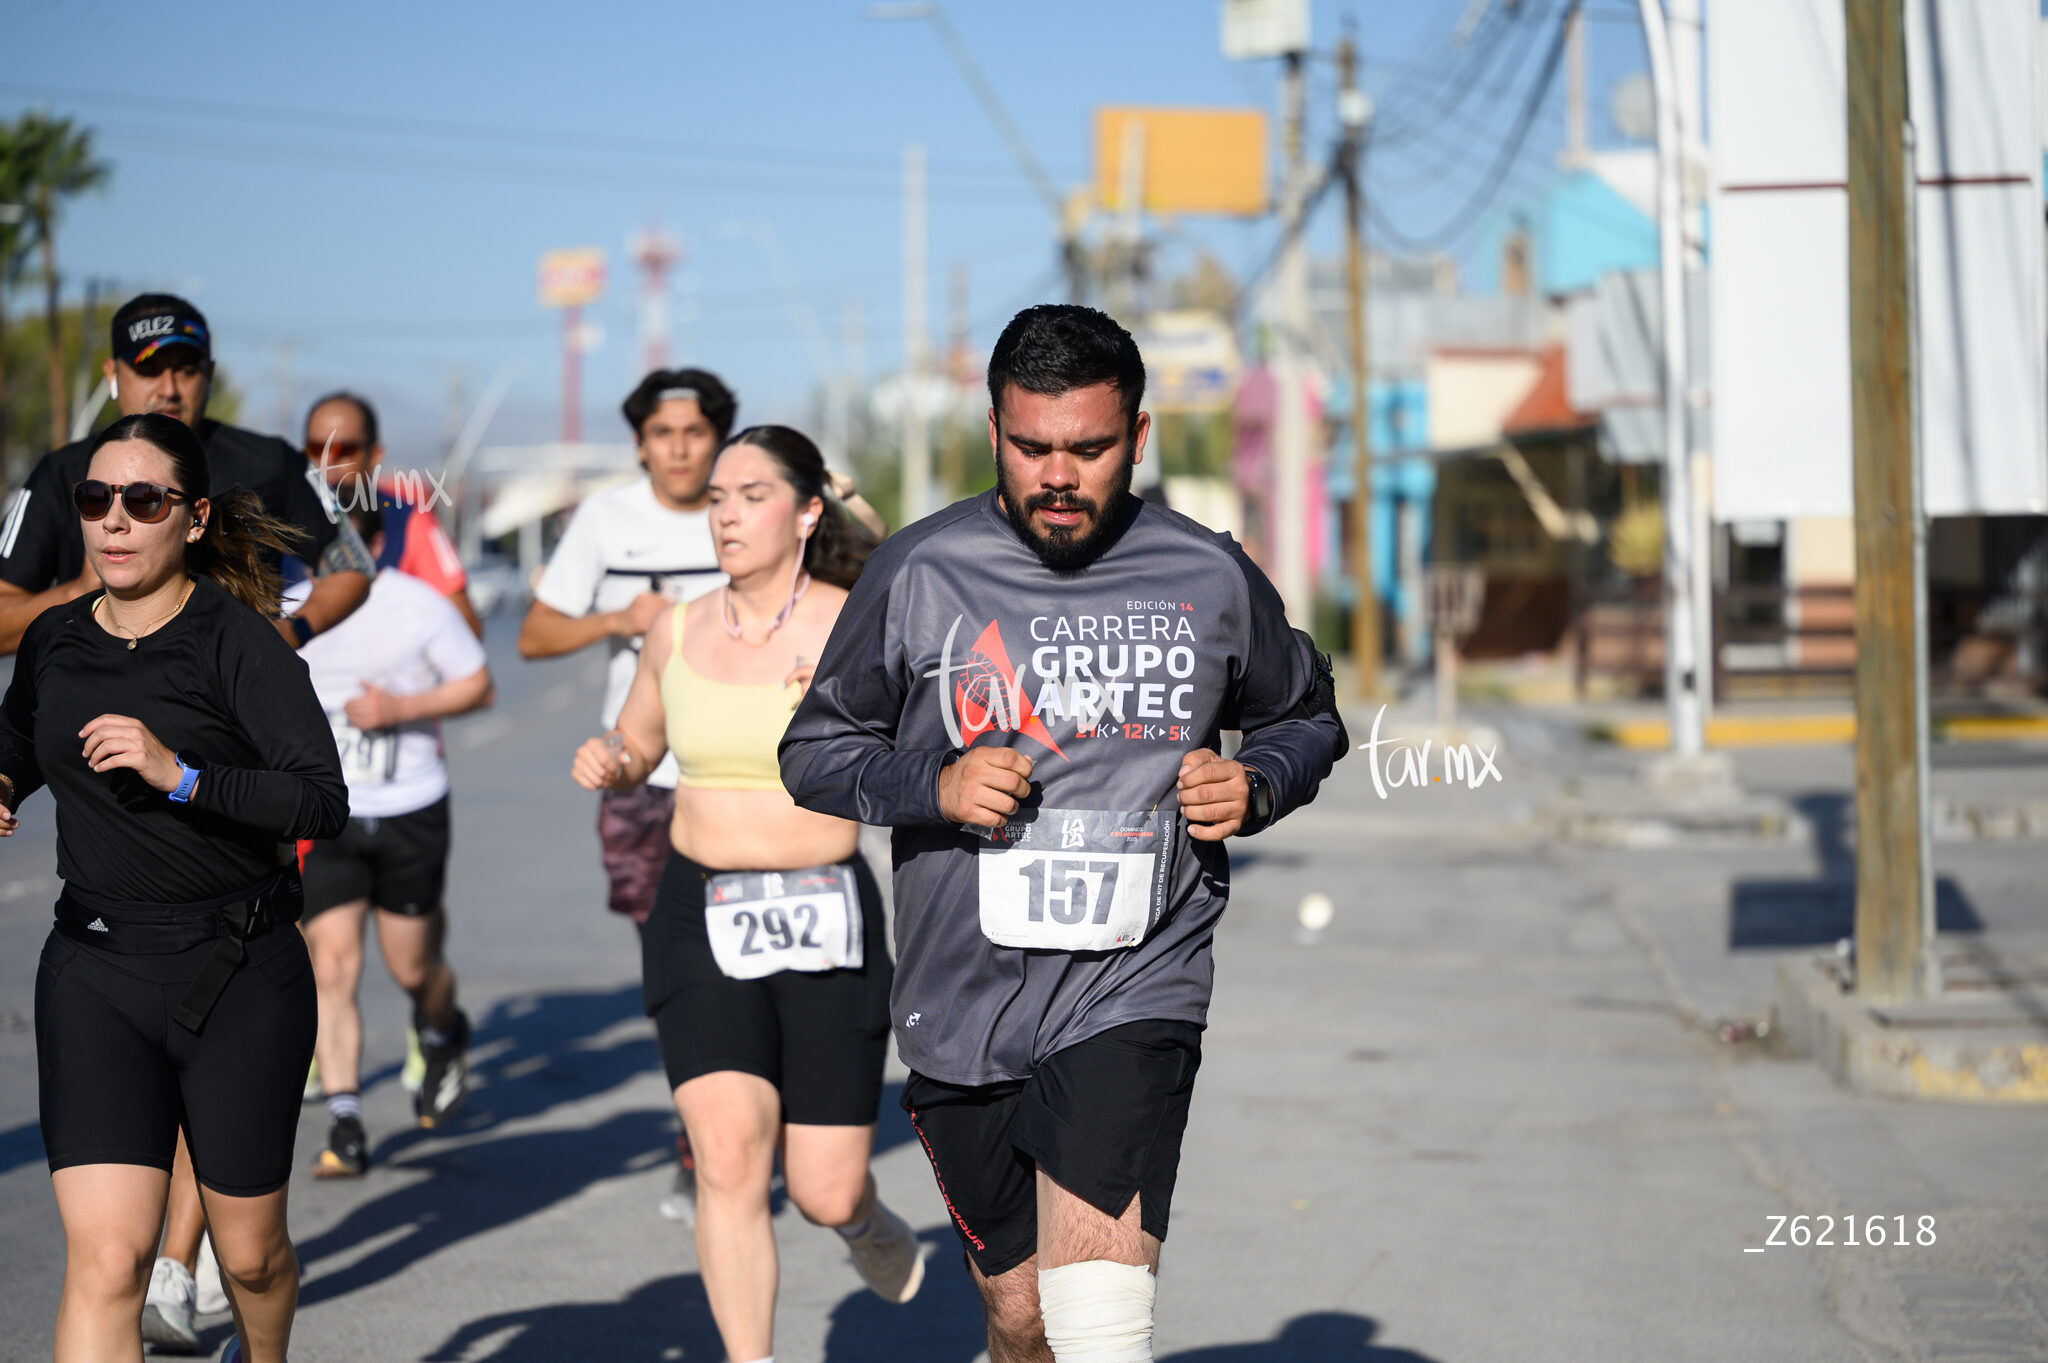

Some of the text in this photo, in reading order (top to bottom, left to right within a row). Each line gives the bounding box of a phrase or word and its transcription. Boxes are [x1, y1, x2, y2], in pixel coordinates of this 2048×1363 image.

[1127, 600, 1194, 612] EDICIÓN 14
[1030, 615, 1196, 642] CARRERA
[1031, 644, 1195, 679] GRUPO
[1031, 682, 1194, 719] ARTEC
[1122, 723, 1156, 740] 12K
[1169, 725, 1191, 741] 5K
[1019, 859, 1119, 925] 157
[733, 904, 822, 956] 292
